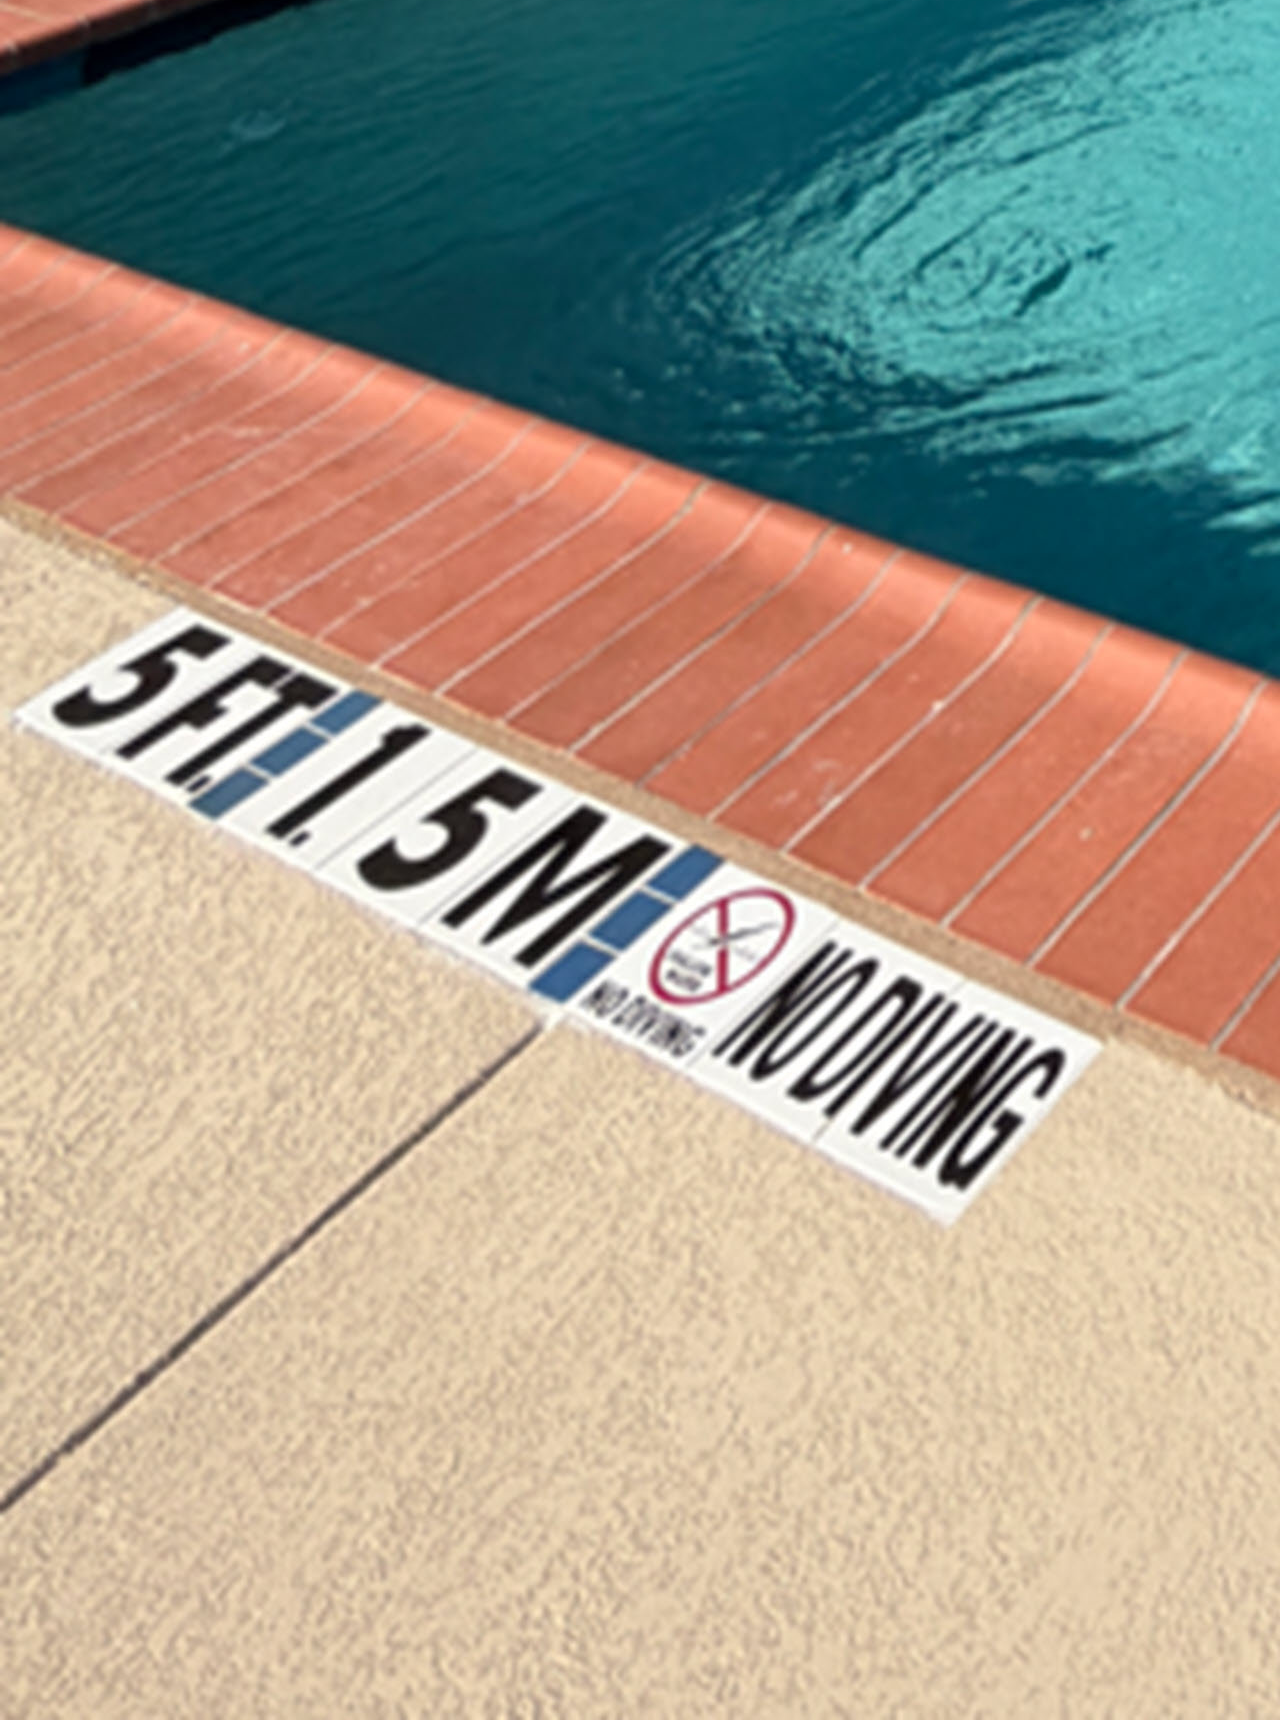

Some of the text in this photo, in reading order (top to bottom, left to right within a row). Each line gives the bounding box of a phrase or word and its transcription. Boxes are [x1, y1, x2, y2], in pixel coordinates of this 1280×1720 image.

[51, 624, 231, 729] 5
[440, 804, 673, 969] M
[712, 940, 1066, 1193] NO DIVING
